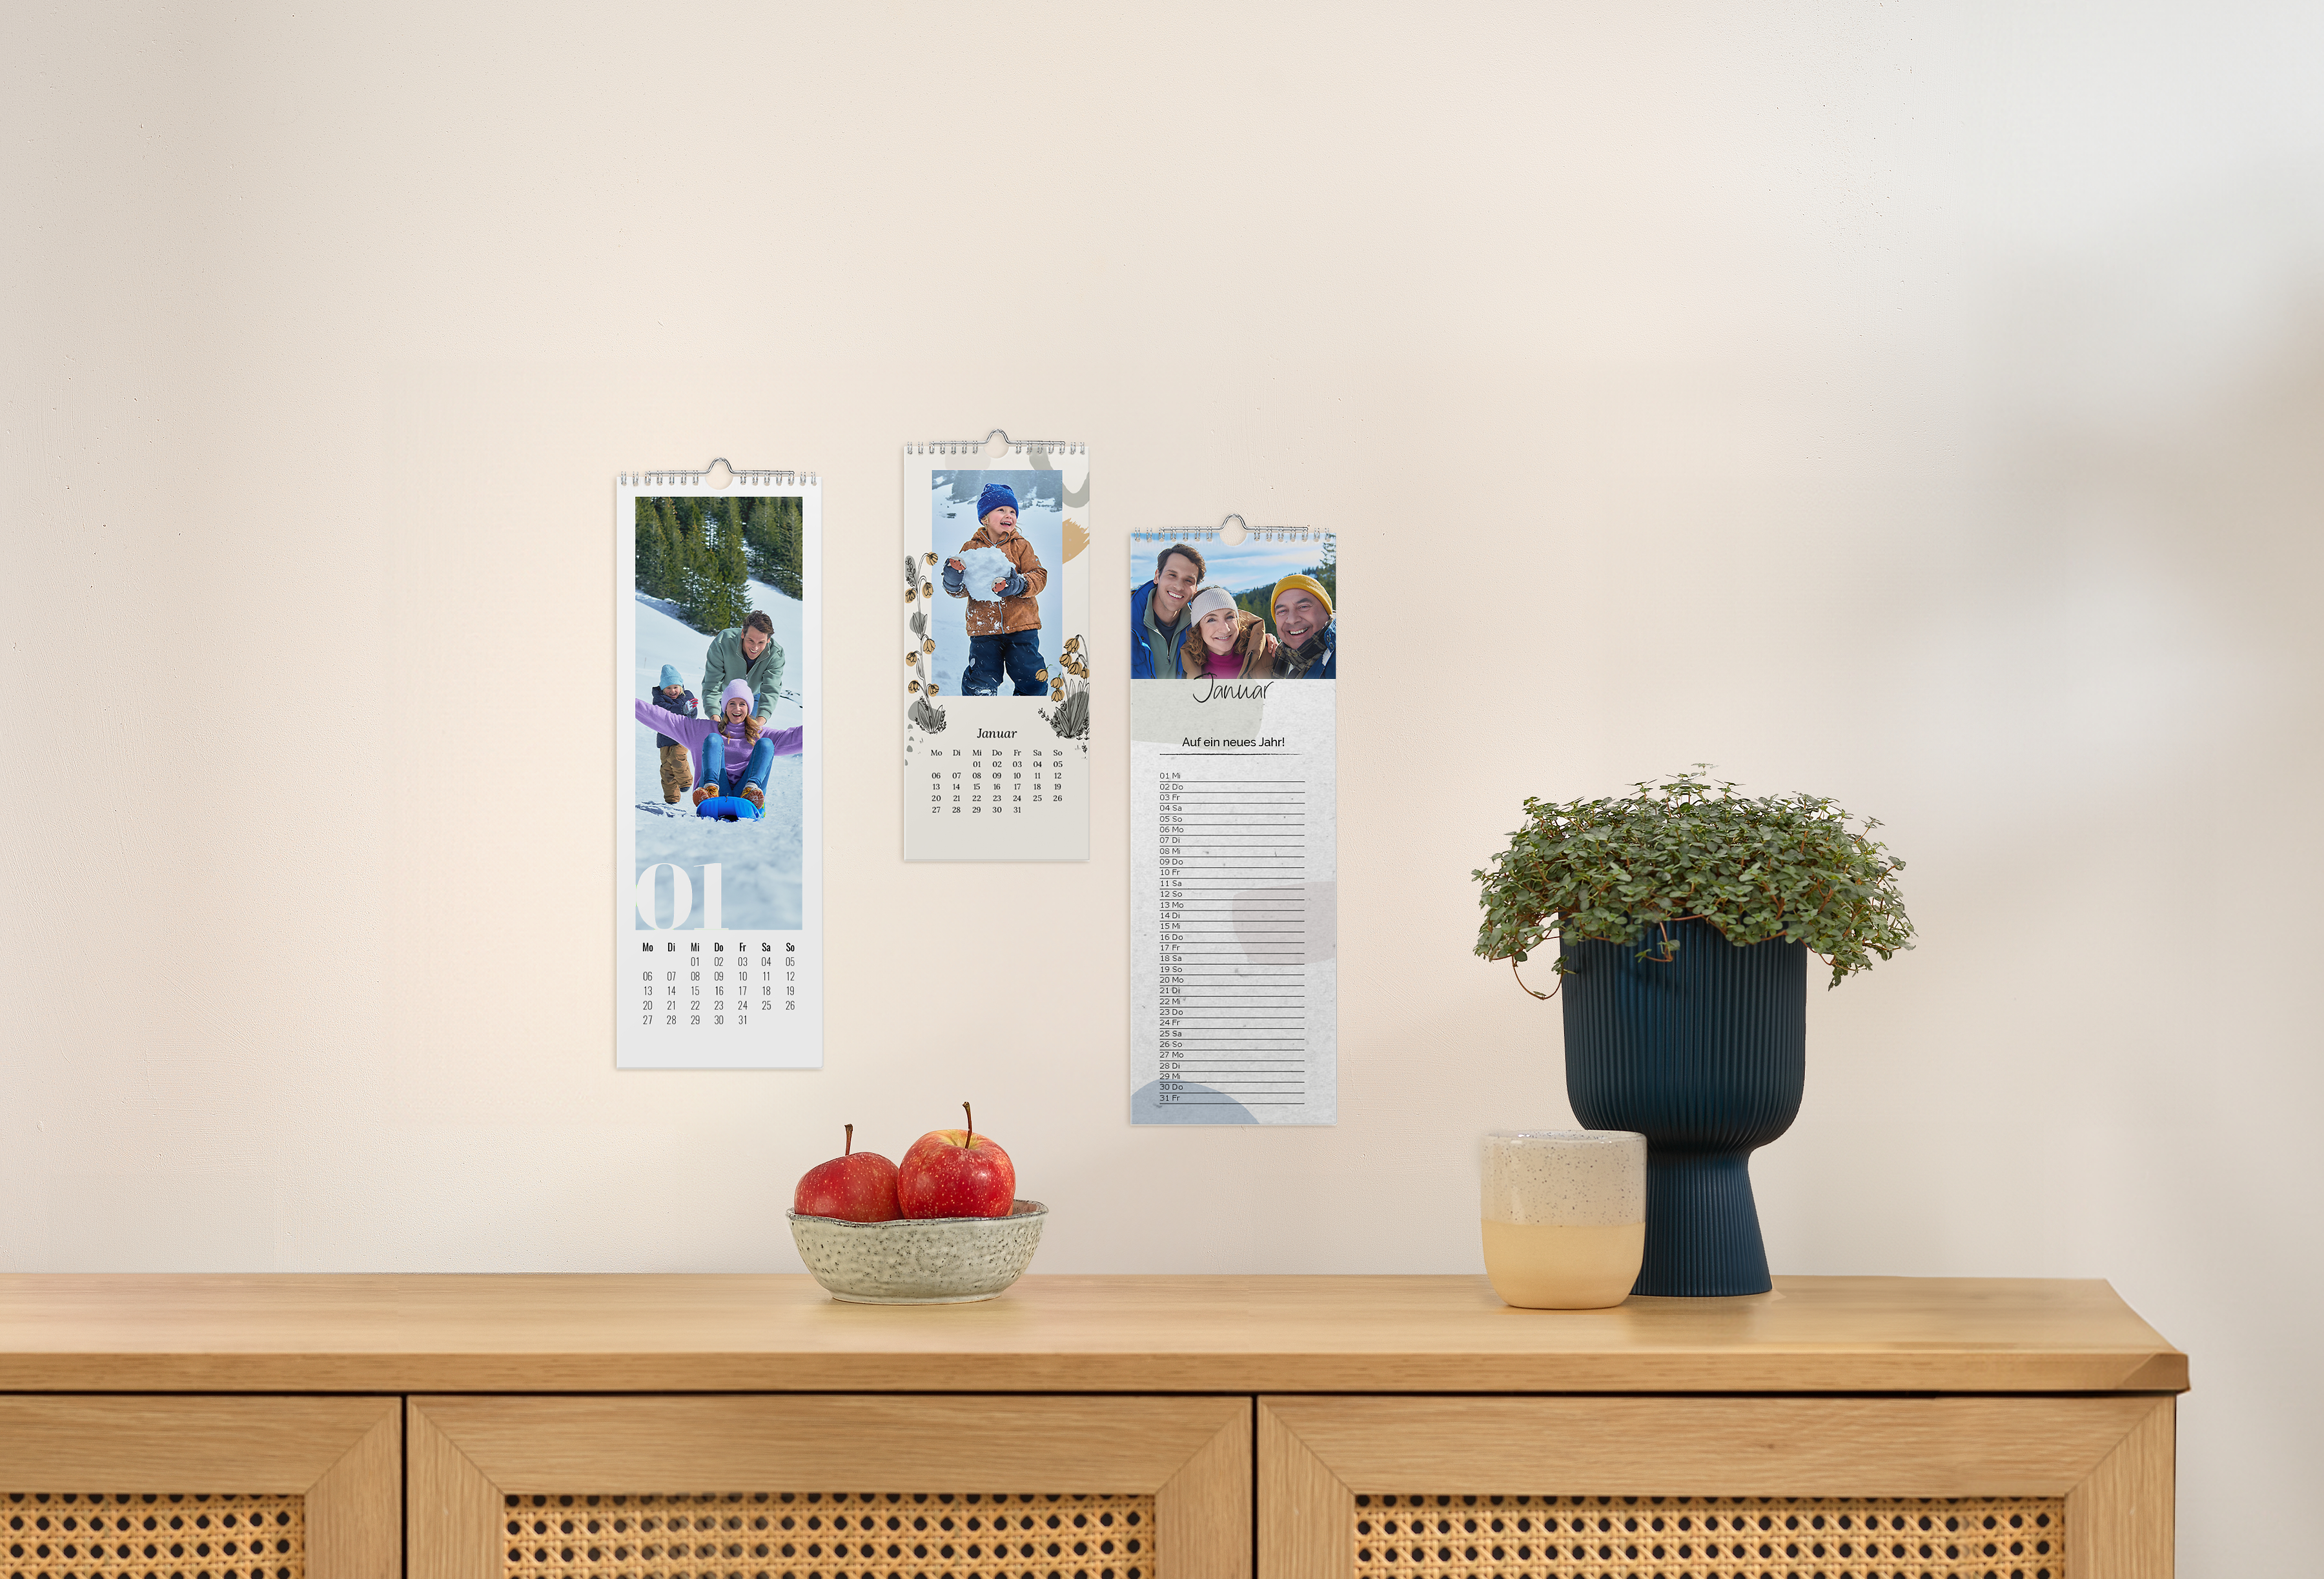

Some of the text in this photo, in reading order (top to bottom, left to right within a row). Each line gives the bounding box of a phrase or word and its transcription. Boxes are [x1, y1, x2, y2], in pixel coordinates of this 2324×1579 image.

[1192, 672, 1274, 703] Januar
[977, 728, 1017, 739] Januar
[1181, 737, 1202, 747] Auf
[1203, 737, 1220, 747] ein
[1258, 737, 1285, 747] Jahr!
[636, 863, 729, 930] 01
[642, 942, 795, 952] Mo Di Mi Do Fr Sa So
[691, 957, 795, 967] 01 02 03 04 05
[643, 971, 795, 981] 06 07 08 09 10 11 12
[644, 986, 795, 996] 13 14 15 16 17 18 19
[642, 1000, 795, 1010] 20 21 22 23 24 25 26
[643, 1015, 747, 1025] 27 28 29 30 31
